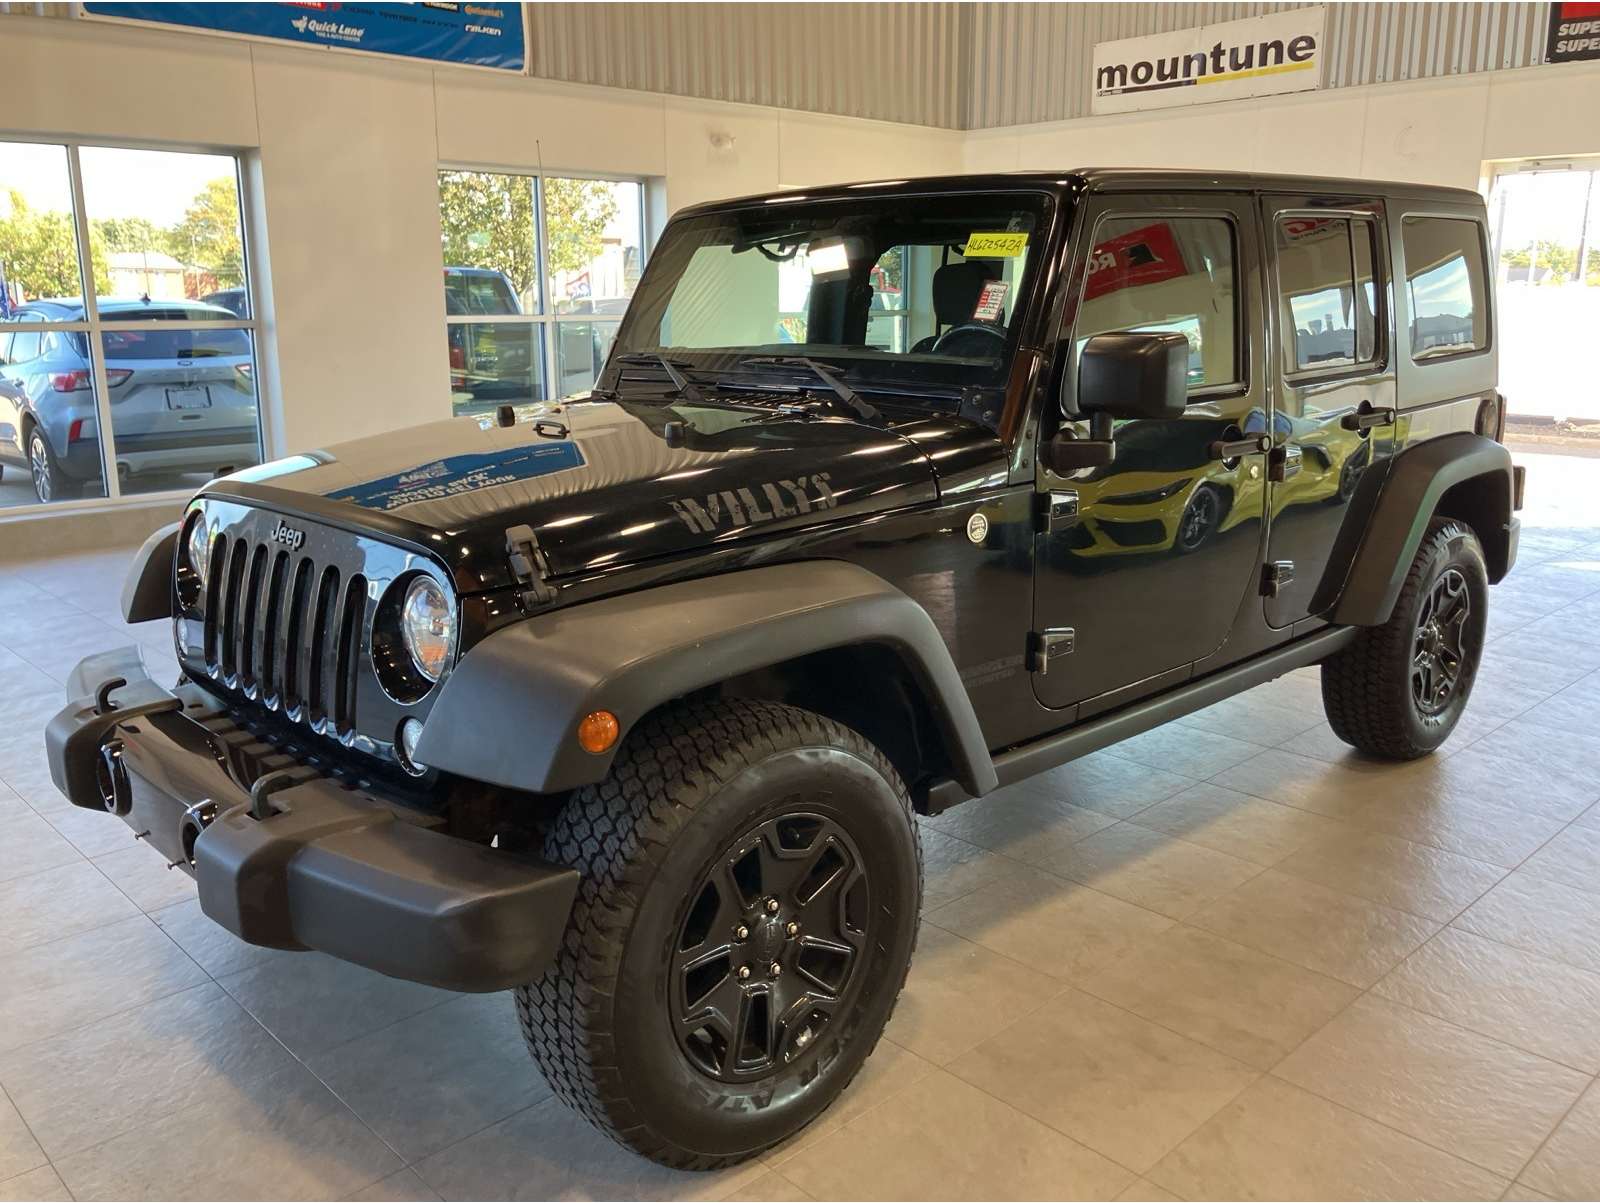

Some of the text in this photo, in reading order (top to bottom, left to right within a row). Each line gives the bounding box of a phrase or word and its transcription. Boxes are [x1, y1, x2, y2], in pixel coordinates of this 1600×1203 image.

[308, 19, 365, 38] Quick Lane
[1096, 34, 1317, 90] mountune
[667, 472, 838, 535] WILLYS
[271, 520, 303, 551] Jeep
